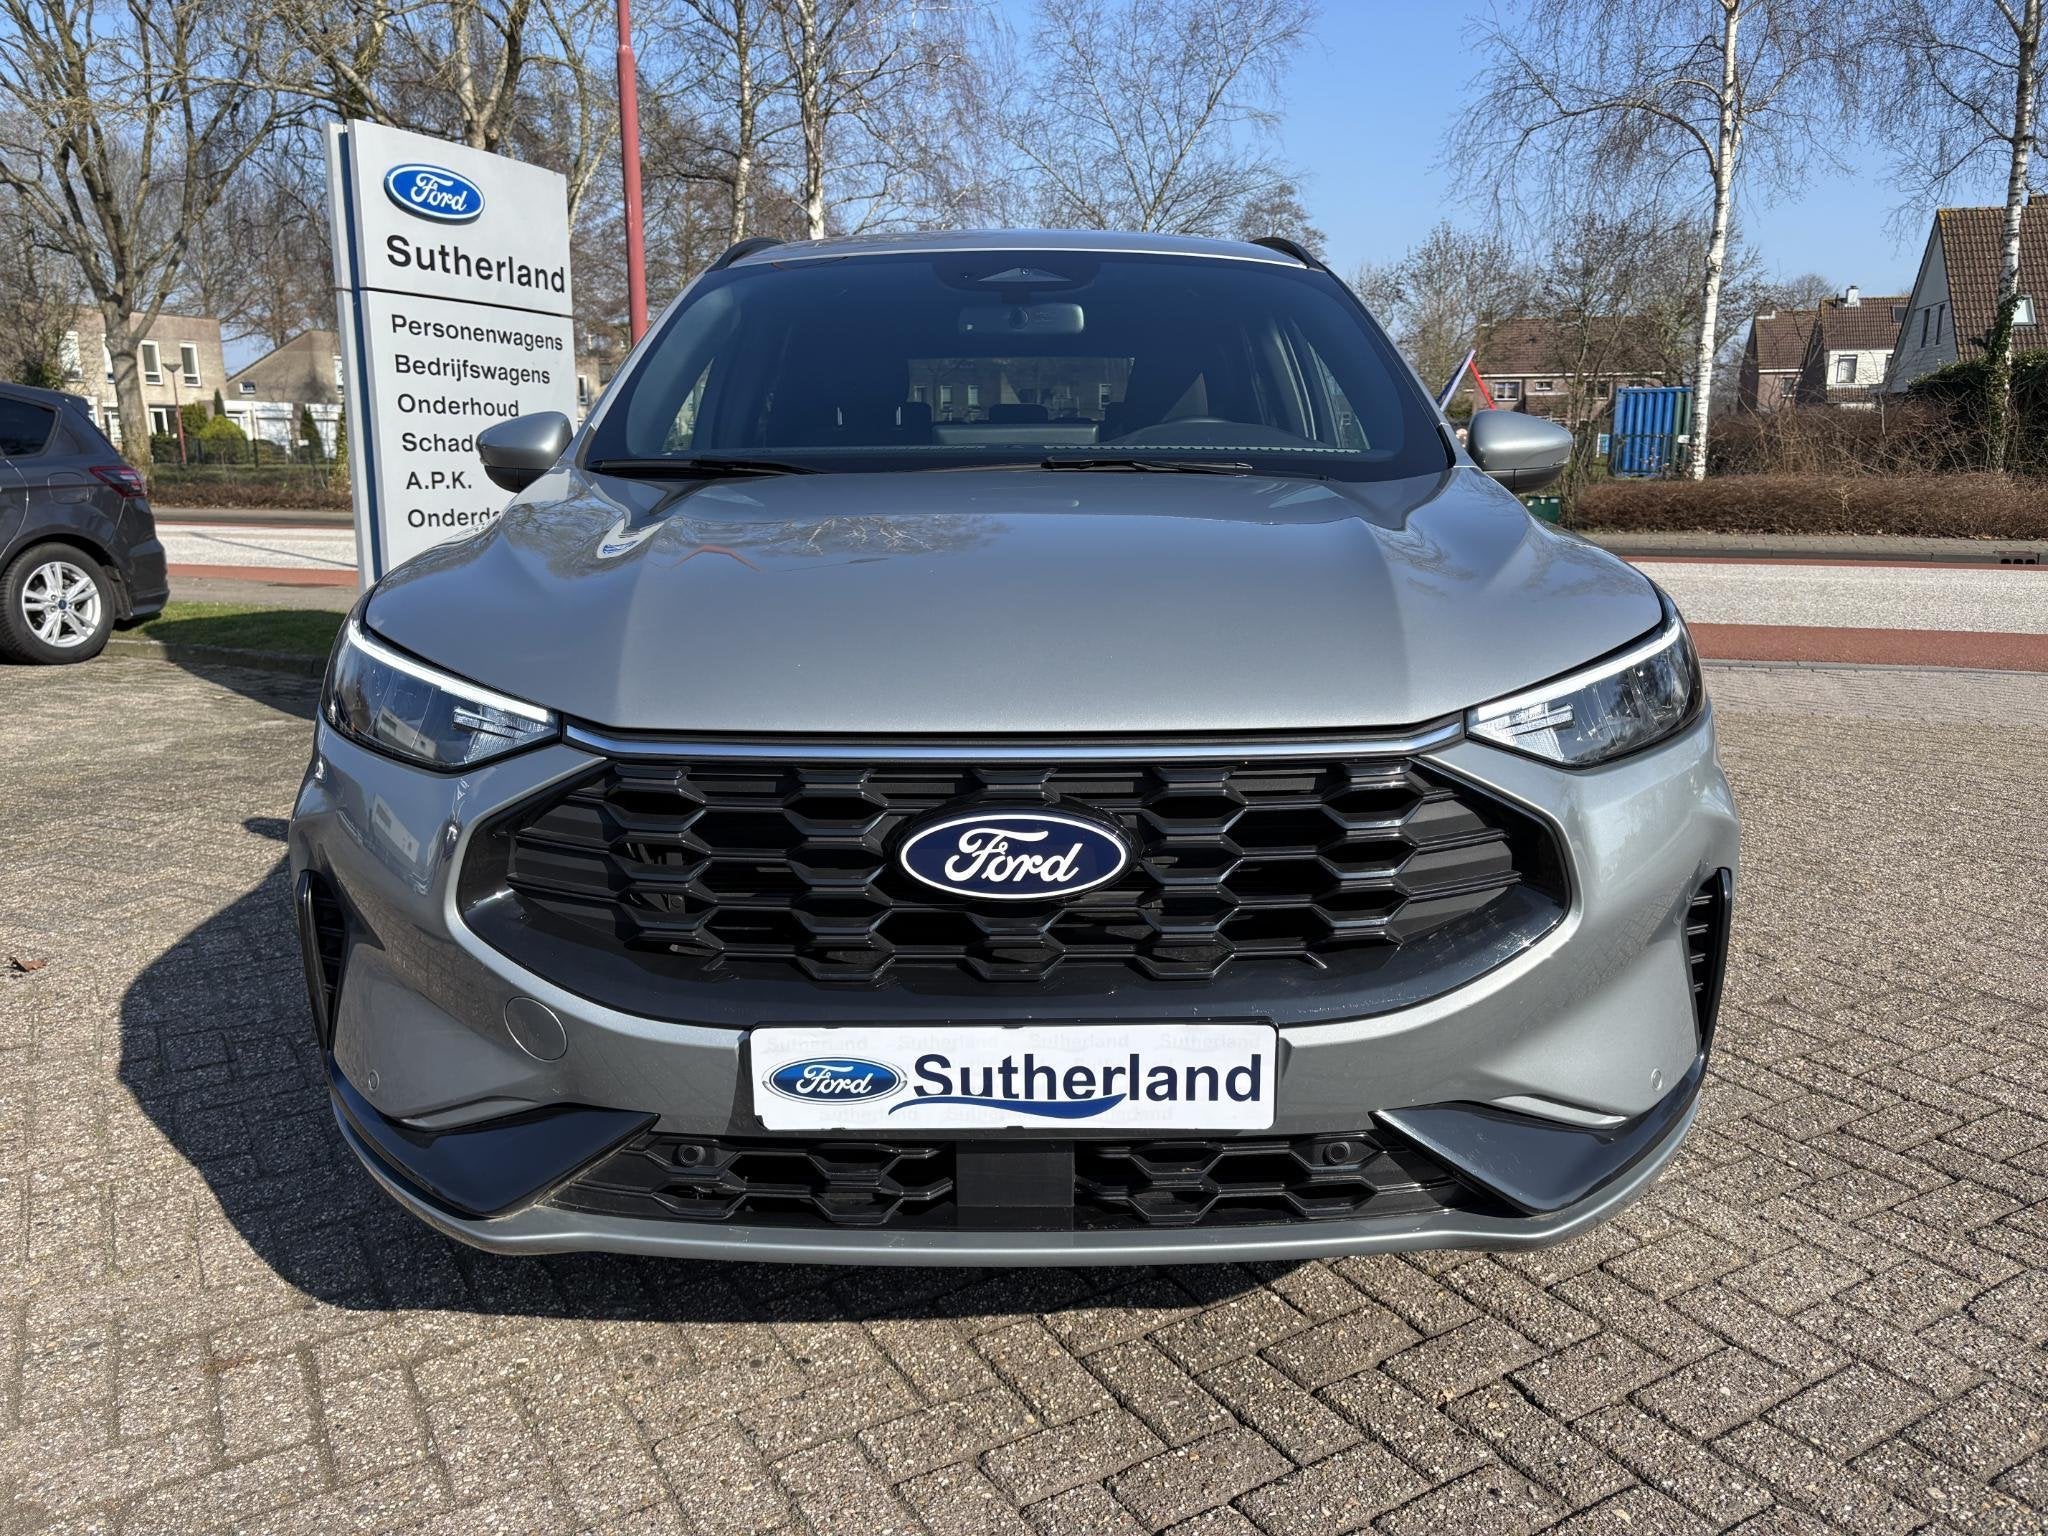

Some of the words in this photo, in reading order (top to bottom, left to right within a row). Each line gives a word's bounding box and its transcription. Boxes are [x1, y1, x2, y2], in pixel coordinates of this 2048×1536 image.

[410, 173, 468, 212] Ford
[386, 234, 565, 293] Sutherland
[391, 313, 563, 351] Personenwagens
[394, 353, 551, 386] Bedrijfswagens
[397, 393, 520, 418] Onderhoud
[402, 432, 474, 453] Schad
[406, 471, 472, 490] A.P.K.
[408, 507, 500, 528] Onderd
[944, 827, 1084, 883] Ford
[796, 1064, 873, 1095] Ford
[914, 1053, 1262, 1102] Sutherland
